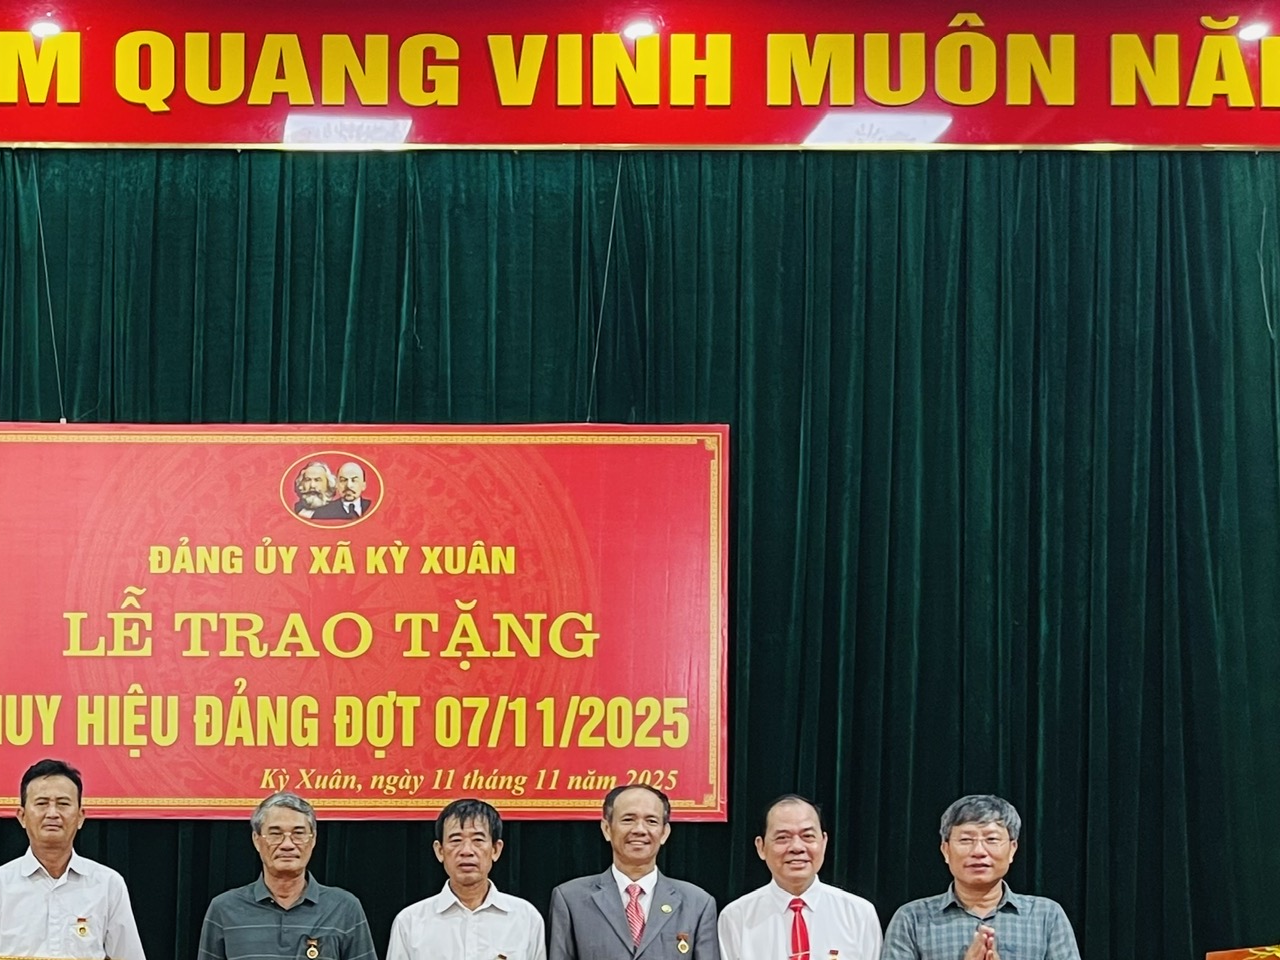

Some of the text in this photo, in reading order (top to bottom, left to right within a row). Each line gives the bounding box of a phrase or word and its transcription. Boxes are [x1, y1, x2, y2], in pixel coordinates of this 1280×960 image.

[114, 30, 460, 112] QUANG
[487, 33, 732, 107] VINH
[766, 12, 1076, 107] MUÔN
[1110, 15, 1280, 108] NĂ
[148, 536, 517, 576] ĐẢNG ỦY XÃ KỲ XUÂN
[63, 586, 600, 671] LỄ TRAO TẶNG
[77, 685, 180, 760] HIỆU
[193, 680, 319, 749] ĐẢNG
[332, 690, 422, 760] ĐỢT
[434, 694, 690, 750] 07/11/2025
[259, 766, 679, 797] Kỳ Xuân, ngày 11 tháng 11 năm 2025
